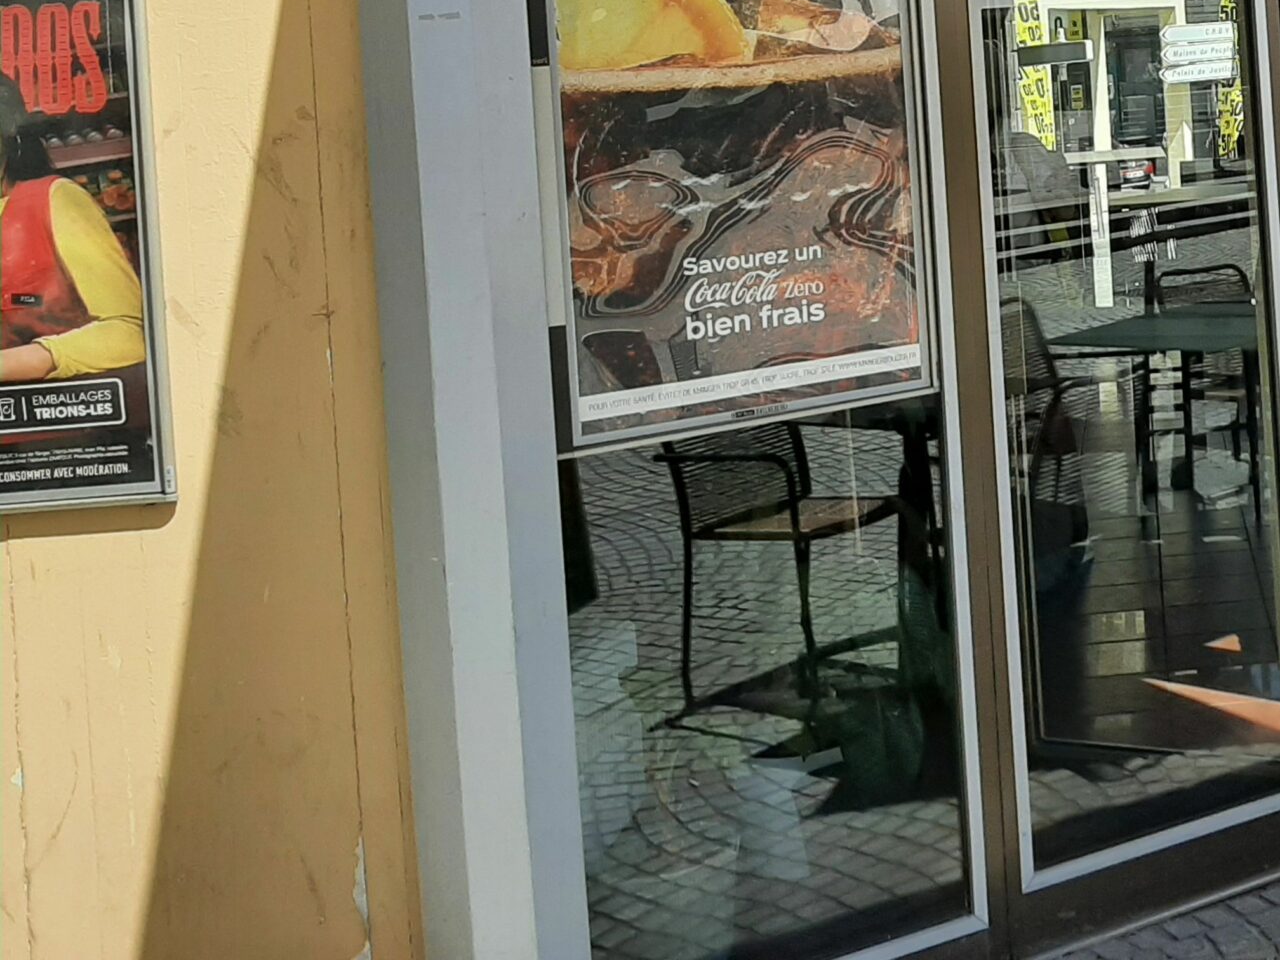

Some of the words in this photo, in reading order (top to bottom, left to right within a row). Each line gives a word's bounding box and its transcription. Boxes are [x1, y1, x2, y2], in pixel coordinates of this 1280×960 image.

[683, 249, 789, 276] Savourez
[795, 244, 822, 261] un
[685, 313, 751, 341] bien
[759, 299, 825, 329] frais
[32, 390, 112, 406] EMBALLAGES
[34, 403, 113, 420] TRIONS-LES
[0, 466, 51, 482] CONSOMMER
[53, 466, 74, 478] AVEC
